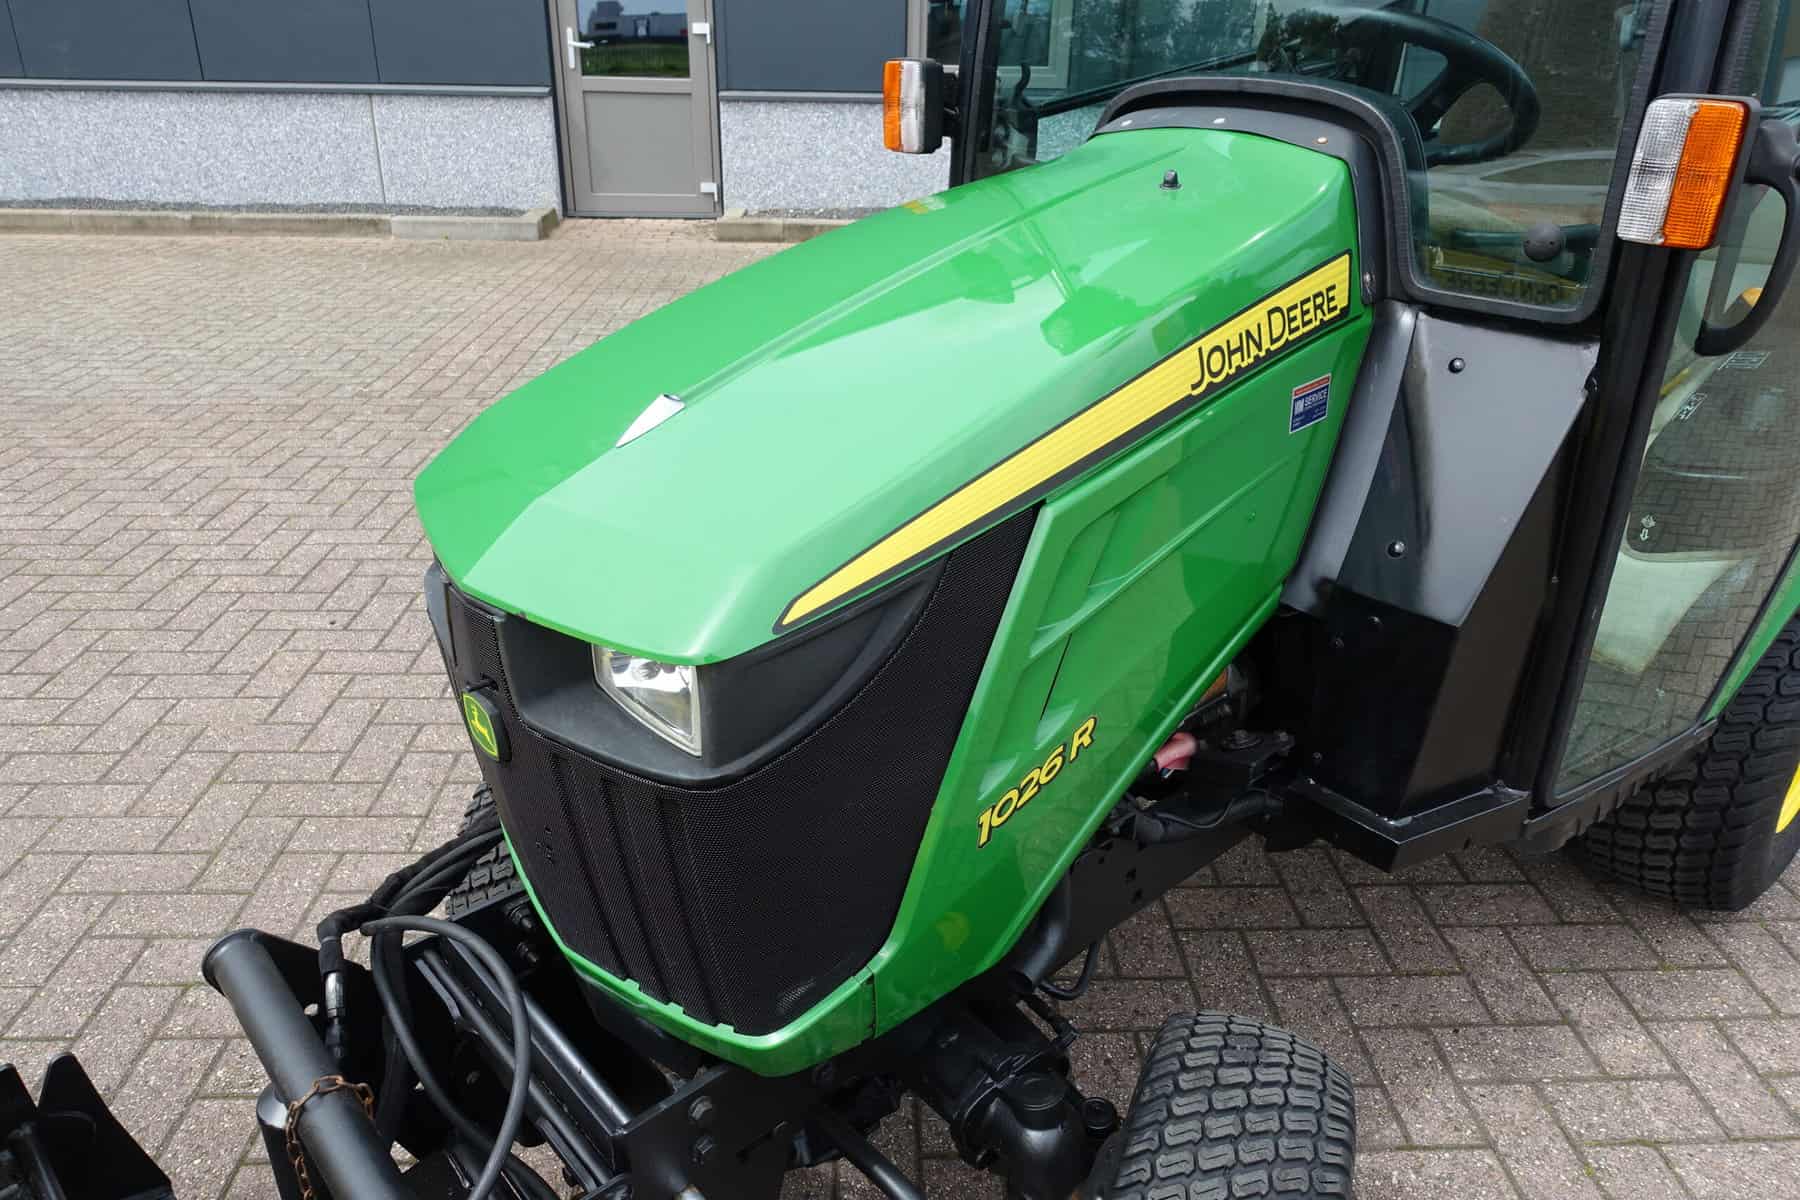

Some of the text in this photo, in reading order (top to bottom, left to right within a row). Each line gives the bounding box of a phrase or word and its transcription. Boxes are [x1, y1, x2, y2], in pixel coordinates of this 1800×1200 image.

[1190, 284, 1338, 391] JOHN DEERE
[978, 717, 1097, 848] 1026 R
